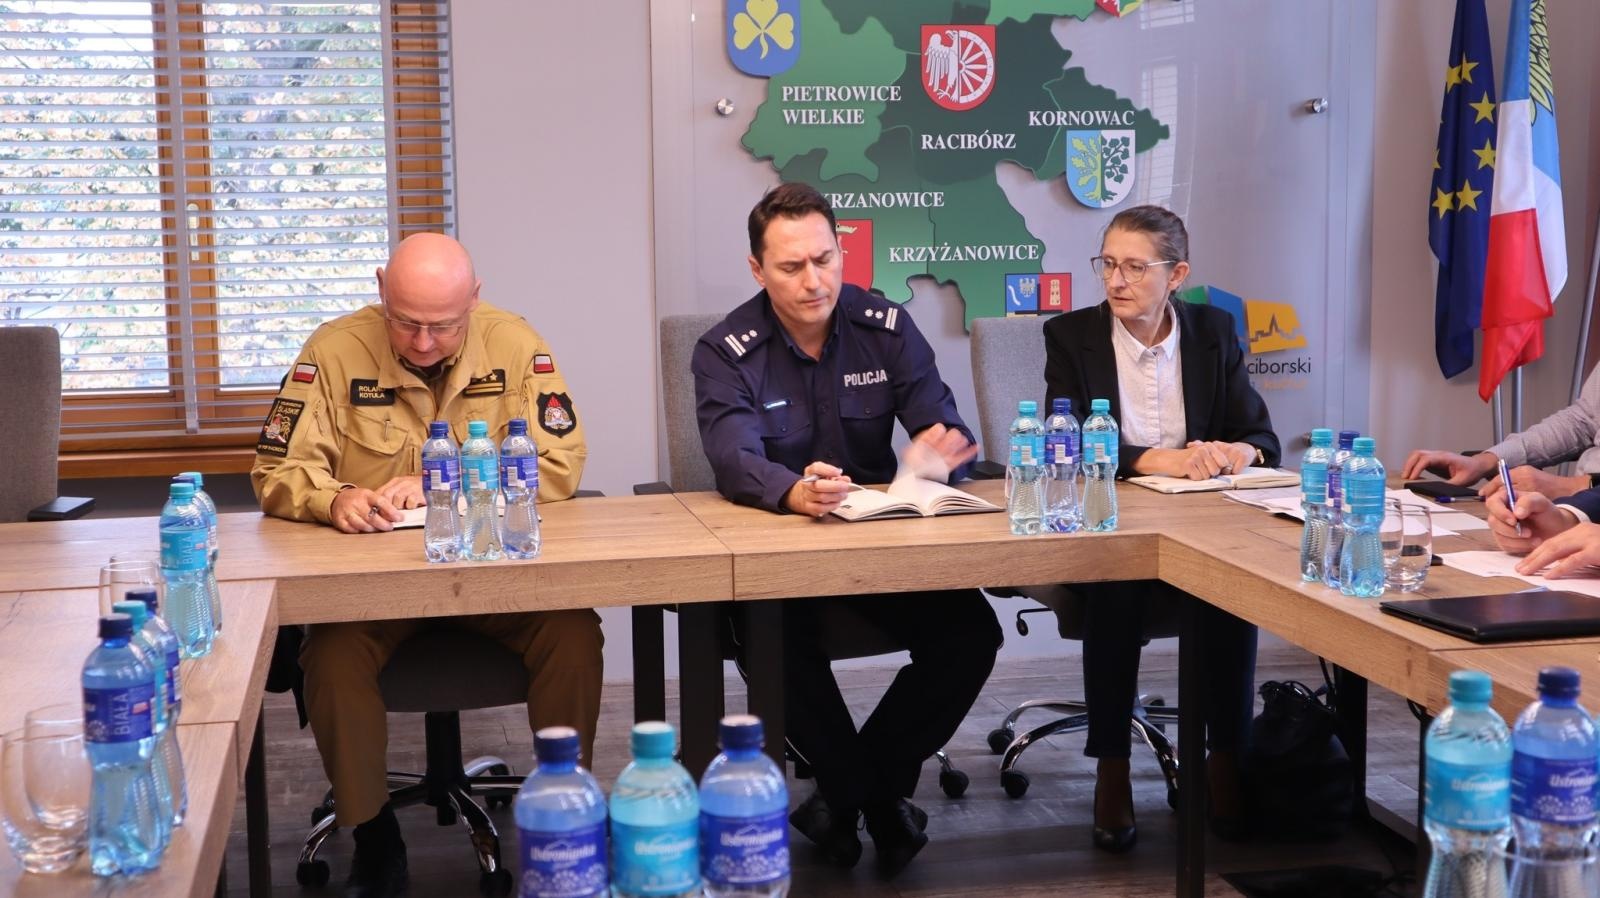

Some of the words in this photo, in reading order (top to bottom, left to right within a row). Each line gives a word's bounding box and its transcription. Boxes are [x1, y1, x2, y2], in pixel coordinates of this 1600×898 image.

[782, 86, 901, 103] PIETROWICE
[783, 108, 865, 125] WIELKIE
[1029, 110, 1135, 127] KORNOWAC
[921, 130, 1016, 150] RACIBÓRZ
[889, 242, 1039, 263] KRZYŻANOWICE
[1247, 356, 1312, 375] ciborski
[843, 369, 888, 388] POLICJA
[181, 536, 194, 564] BIAŁA
[113, 692, 130, 735] BIAŁA
